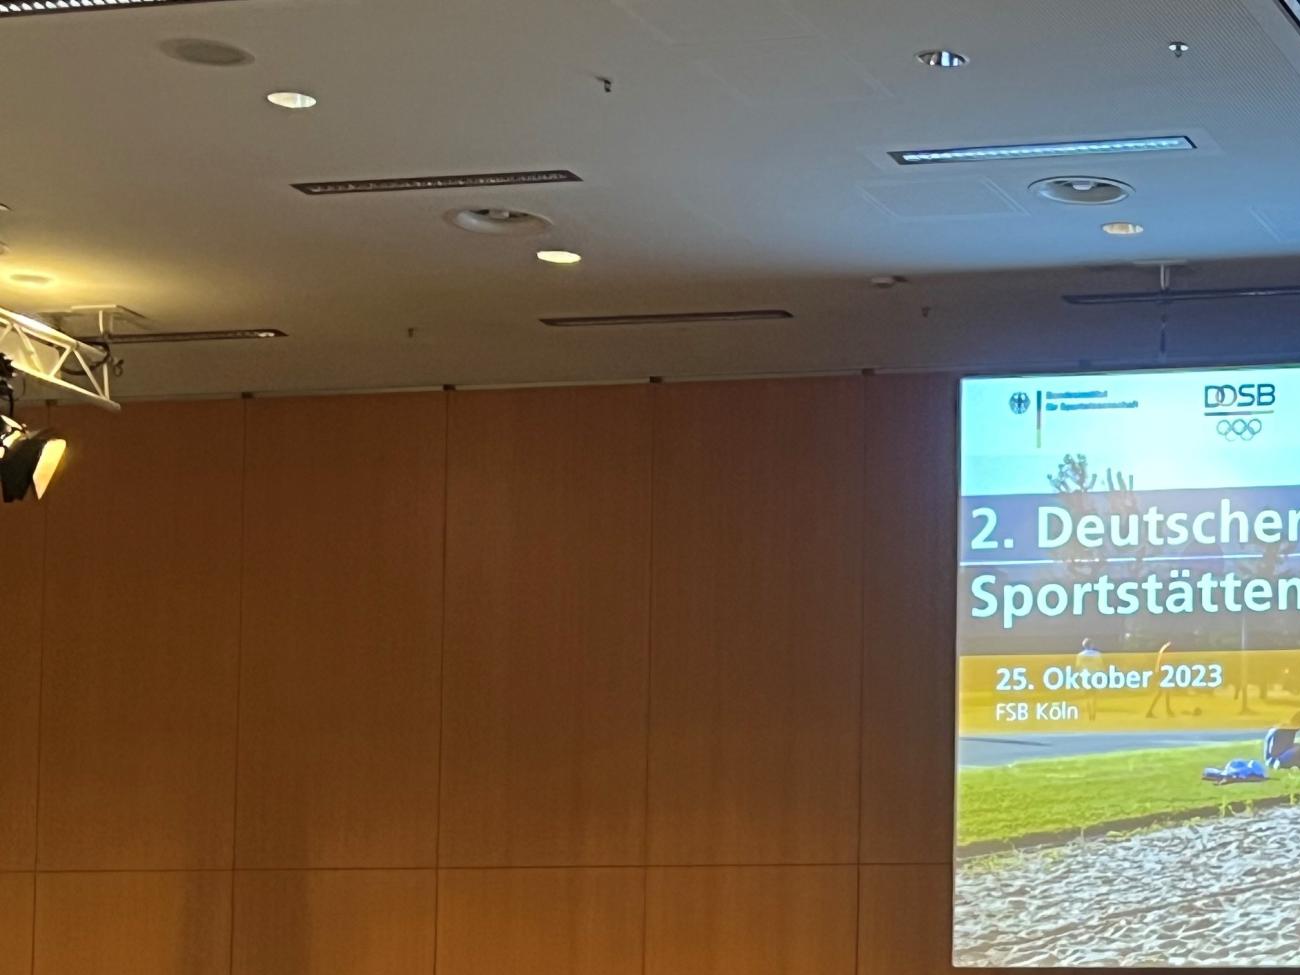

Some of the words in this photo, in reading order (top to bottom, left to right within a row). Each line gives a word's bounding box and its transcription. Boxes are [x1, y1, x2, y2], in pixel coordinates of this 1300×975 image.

[1204, 383, 1276, 408] DOSB
[970, 507, 1014, 550] 2.
[995, 667, 1035, 691] 25.
[1043, 665, 1153, 690] Oktober
[1160, 664, 1223, 689] 2023
[995, 703, 1029, 721] FSB
[1036, 703, 1079, 721] Köln
